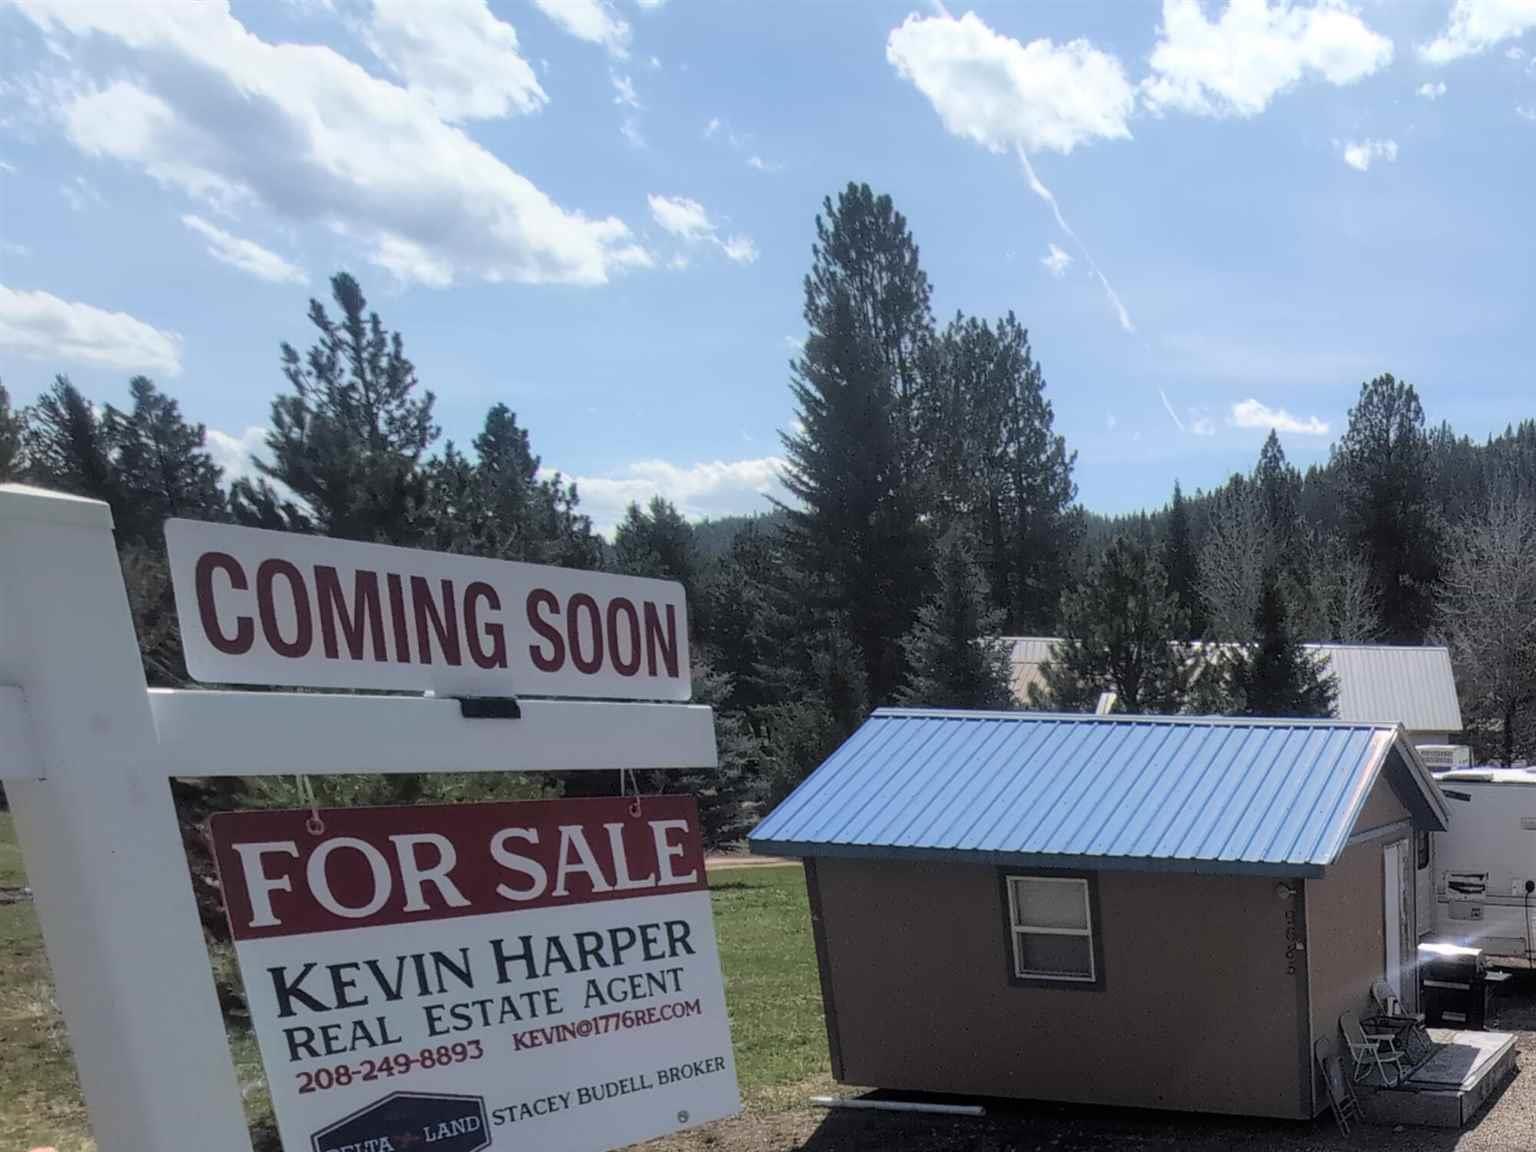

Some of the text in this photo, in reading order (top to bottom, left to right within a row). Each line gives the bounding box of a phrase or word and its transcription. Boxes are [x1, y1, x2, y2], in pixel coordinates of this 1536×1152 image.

[195, 550, 681, 678] COMING SOON
[232, 818, 698, 929] FOR SALE
[267, 919, 696, 1018] KEVIN HARPER
[283, 967, 685, 1062] REAL ESTATE AGENT
[512, 998, 702, 1051] KEVIN@1776RE.COM
[296, 1039, 485, 1094] 208-249-8893
[492, 1091, 571, 1126] STACEY
[657, 1056, 726, 1086] BROKER
[423, 1115, 480, 1142] LAND
